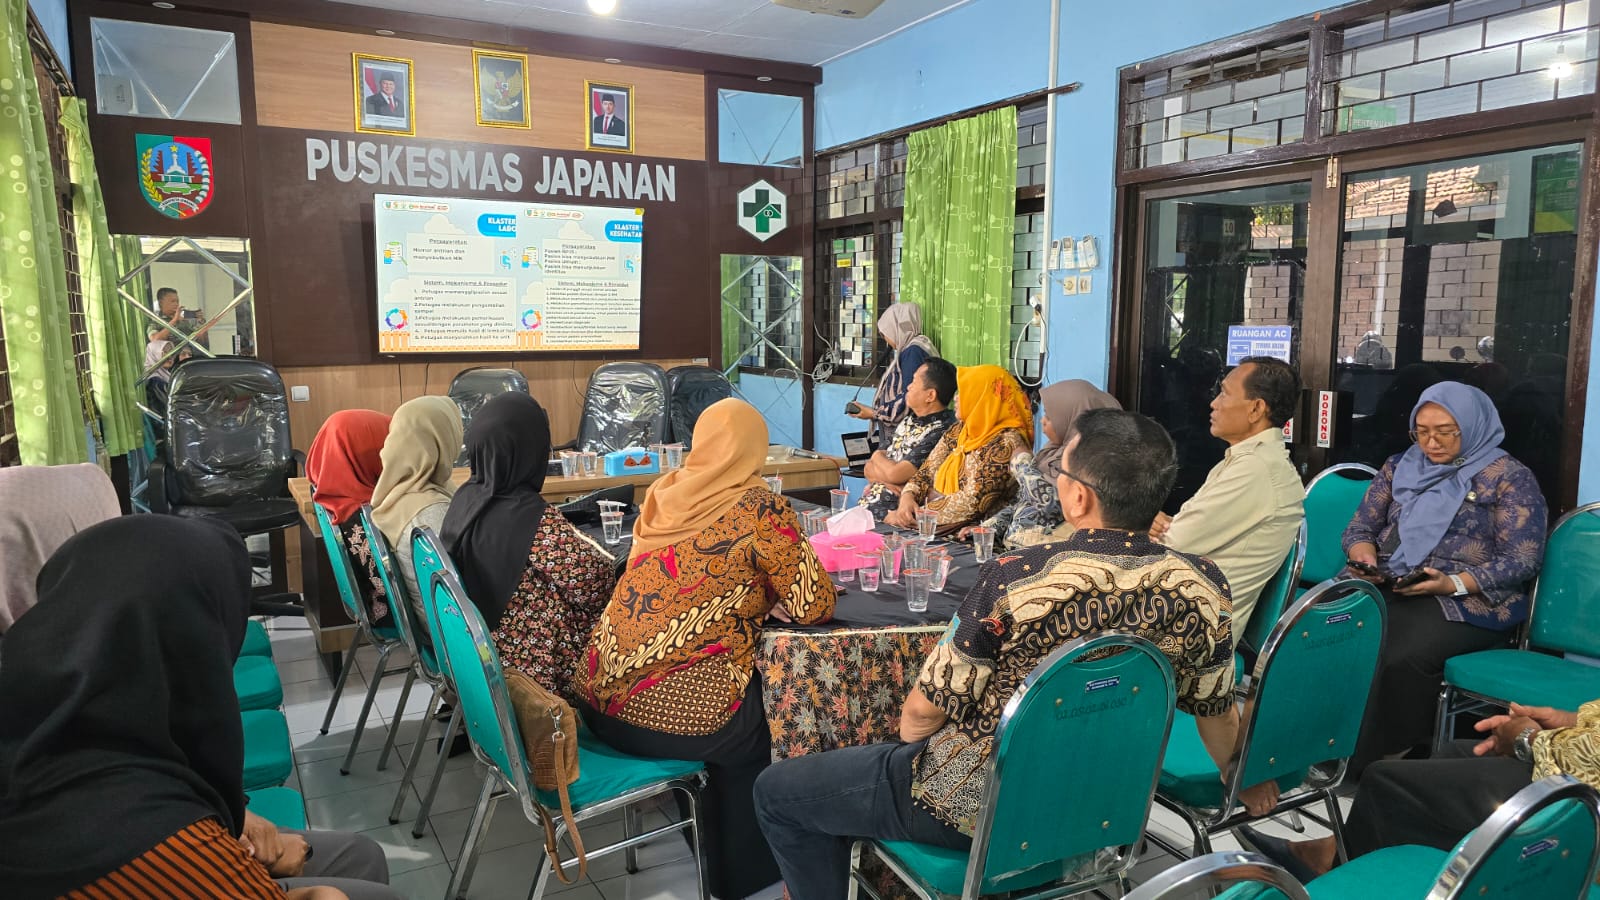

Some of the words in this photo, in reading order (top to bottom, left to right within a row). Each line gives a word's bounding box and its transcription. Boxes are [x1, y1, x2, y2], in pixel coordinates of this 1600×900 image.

[305, 138, 523, 193] PUSKESMAS
[534, 155, 676, 202] JAPANAN
[614, 223, 638, 231] KLASTER
[1231, 329, 1272, 338] RUANGAN
[1274, 329, 1287, 338] AC
[1320, 394, 1328, 440] DORONG
